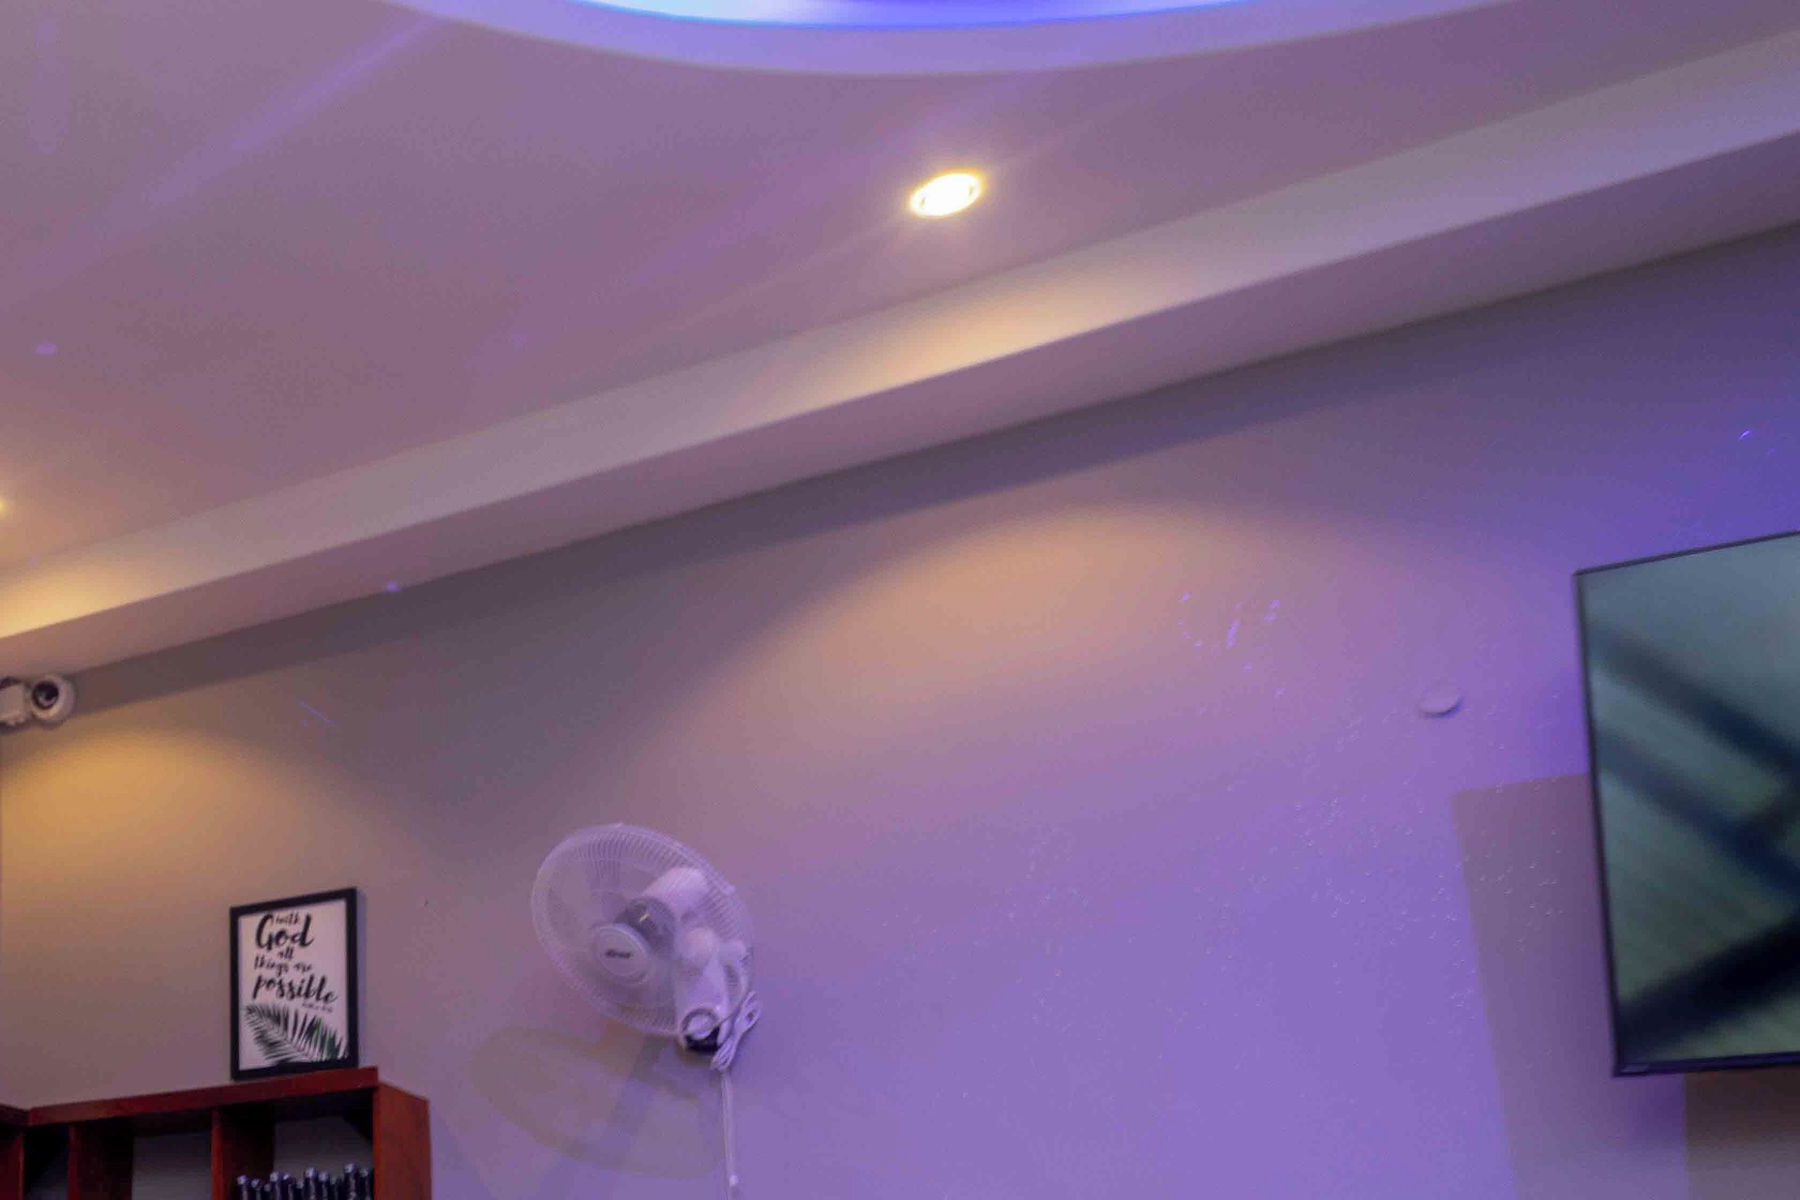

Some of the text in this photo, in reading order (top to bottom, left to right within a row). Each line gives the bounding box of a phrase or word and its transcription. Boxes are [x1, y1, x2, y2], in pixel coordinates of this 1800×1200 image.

[256, 913, 314, 951] God
[279, 946, 294, 960] all
[255, 956, 312, 977] things are
[253, 974, 338, 1005] possible
